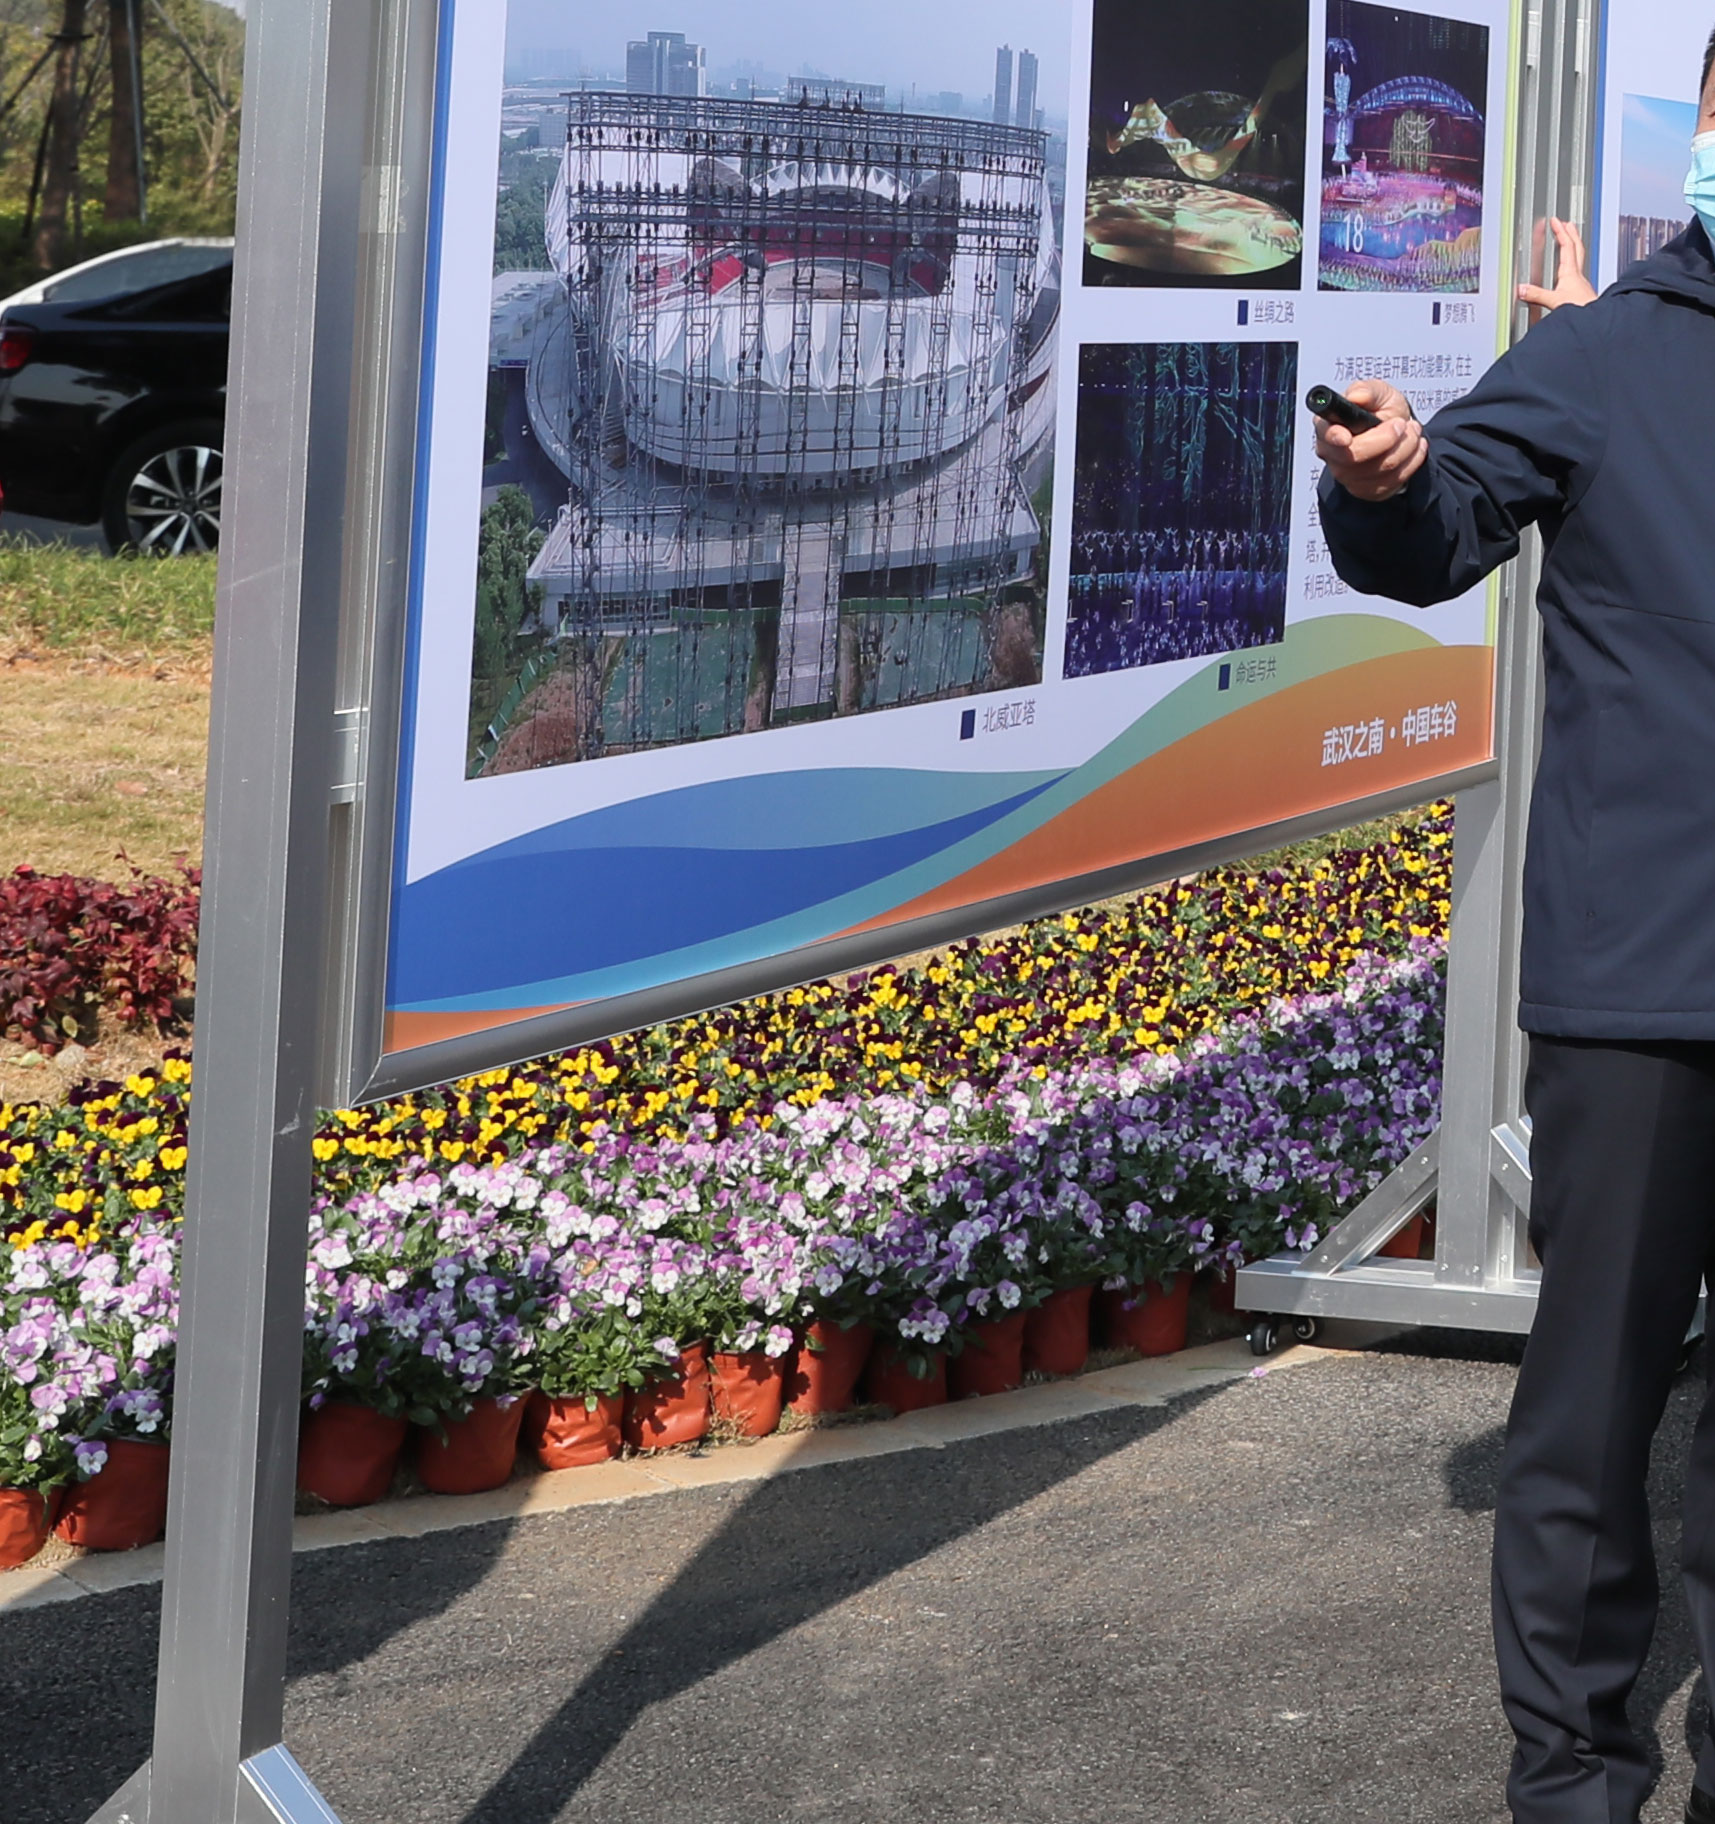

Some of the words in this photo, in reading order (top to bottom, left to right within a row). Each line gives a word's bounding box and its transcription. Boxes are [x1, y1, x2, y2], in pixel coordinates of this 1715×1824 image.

[1253, 299, 1295, 325] 丝绸之路
[1235, 655, 1277, 684] 命运与共
[981, 699, 1036, 733] 北威亚塔
